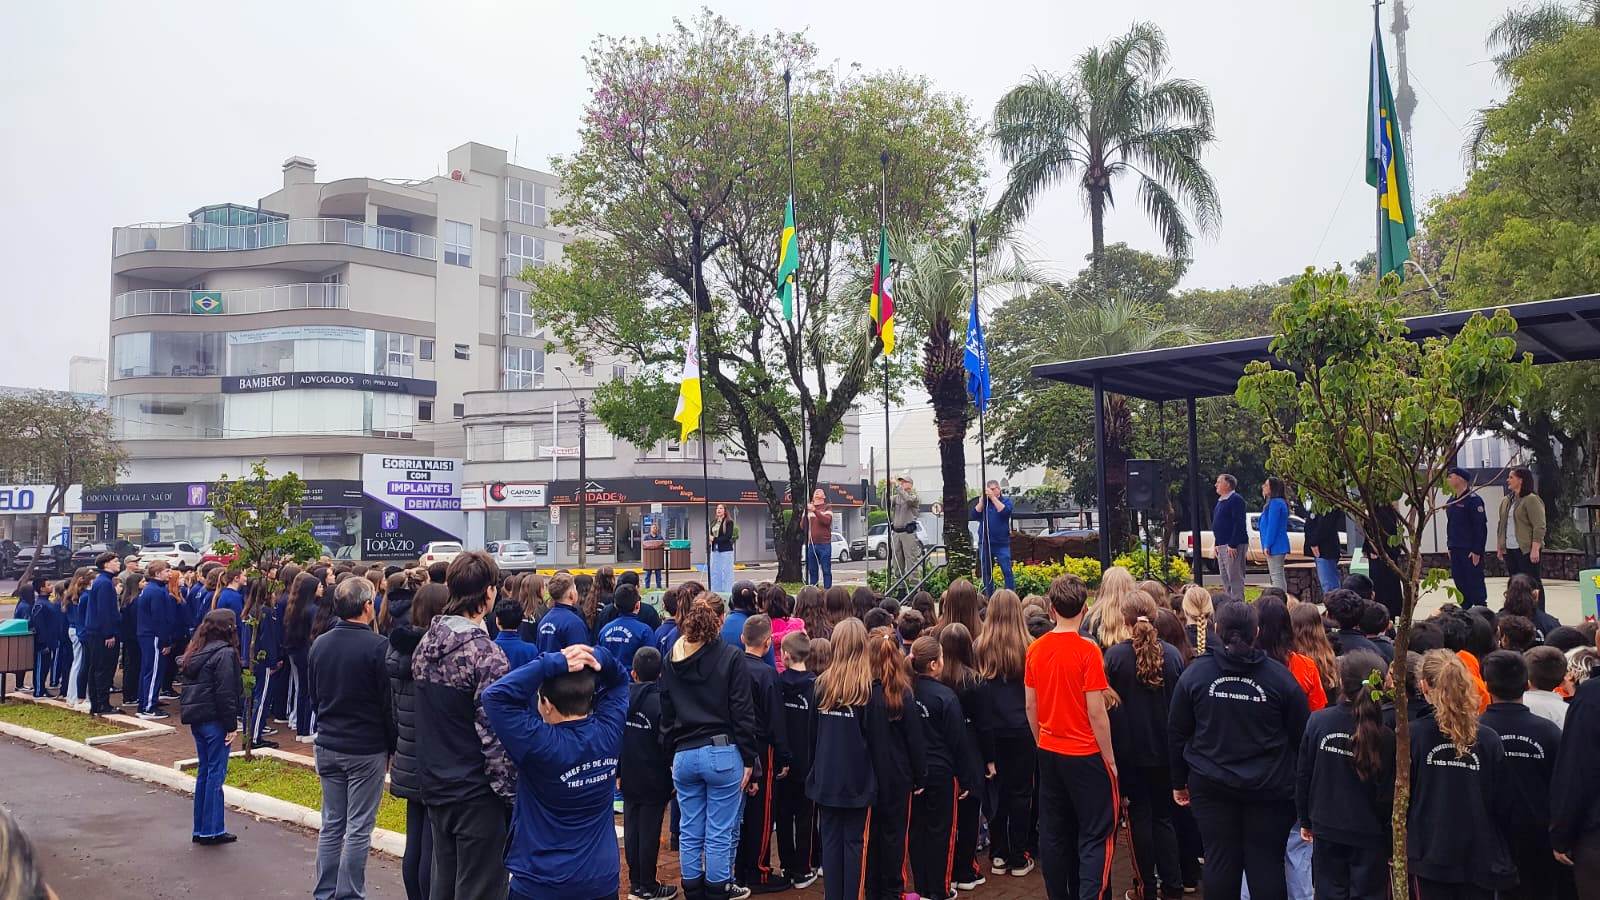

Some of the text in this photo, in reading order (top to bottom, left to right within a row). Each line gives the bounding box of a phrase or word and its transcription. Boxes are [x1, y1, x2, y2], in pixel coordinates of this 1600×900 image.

[239, 376, 286, 389] BAMBERG
[300, 376, 354, 384] ADVOGADOS
[384, 459, 452, 470] SORRIA MAIS!
[410, 472, 428, 480] COM
[391, 482, 450, 493] IMPLANTES
[580, 492, 617, 502] IDADE
[408, 498, 460, 509] DENTÁRIO
[364, 537, 415, 551] TOPÁZIO
[560, 766, 581, 782] EMEF
[582, 763, 591, 771] 25
[592, 760, 601, 768] DE
[567, 780, 584, 788] TRÊS
[585, 773, 608, 784] PASSOS
